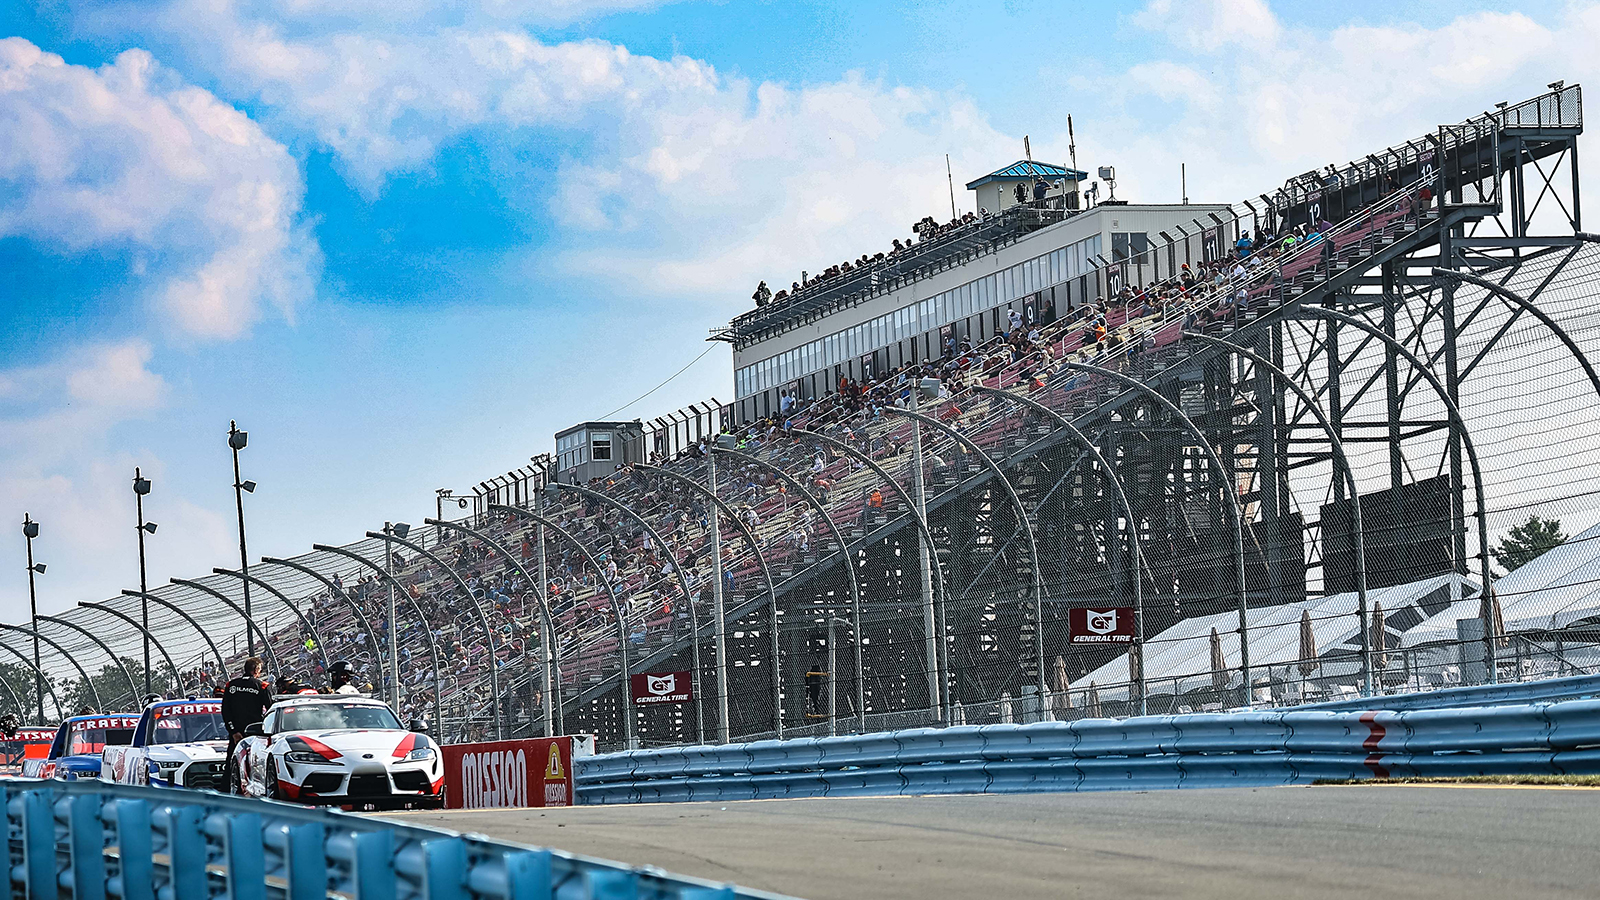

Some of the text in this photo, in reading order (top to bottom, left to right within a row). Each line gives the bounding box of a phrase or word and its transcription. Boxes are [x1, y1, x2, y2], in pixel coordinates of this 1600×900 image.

[1206, 240, 1217, 262] 11
[1109, 274, 1120, 297] 10
[1027, 305, 1034, 325] 9
[236, 686, 259, 695] ILMOR
[636, 695, 671, 703] GENERAL
